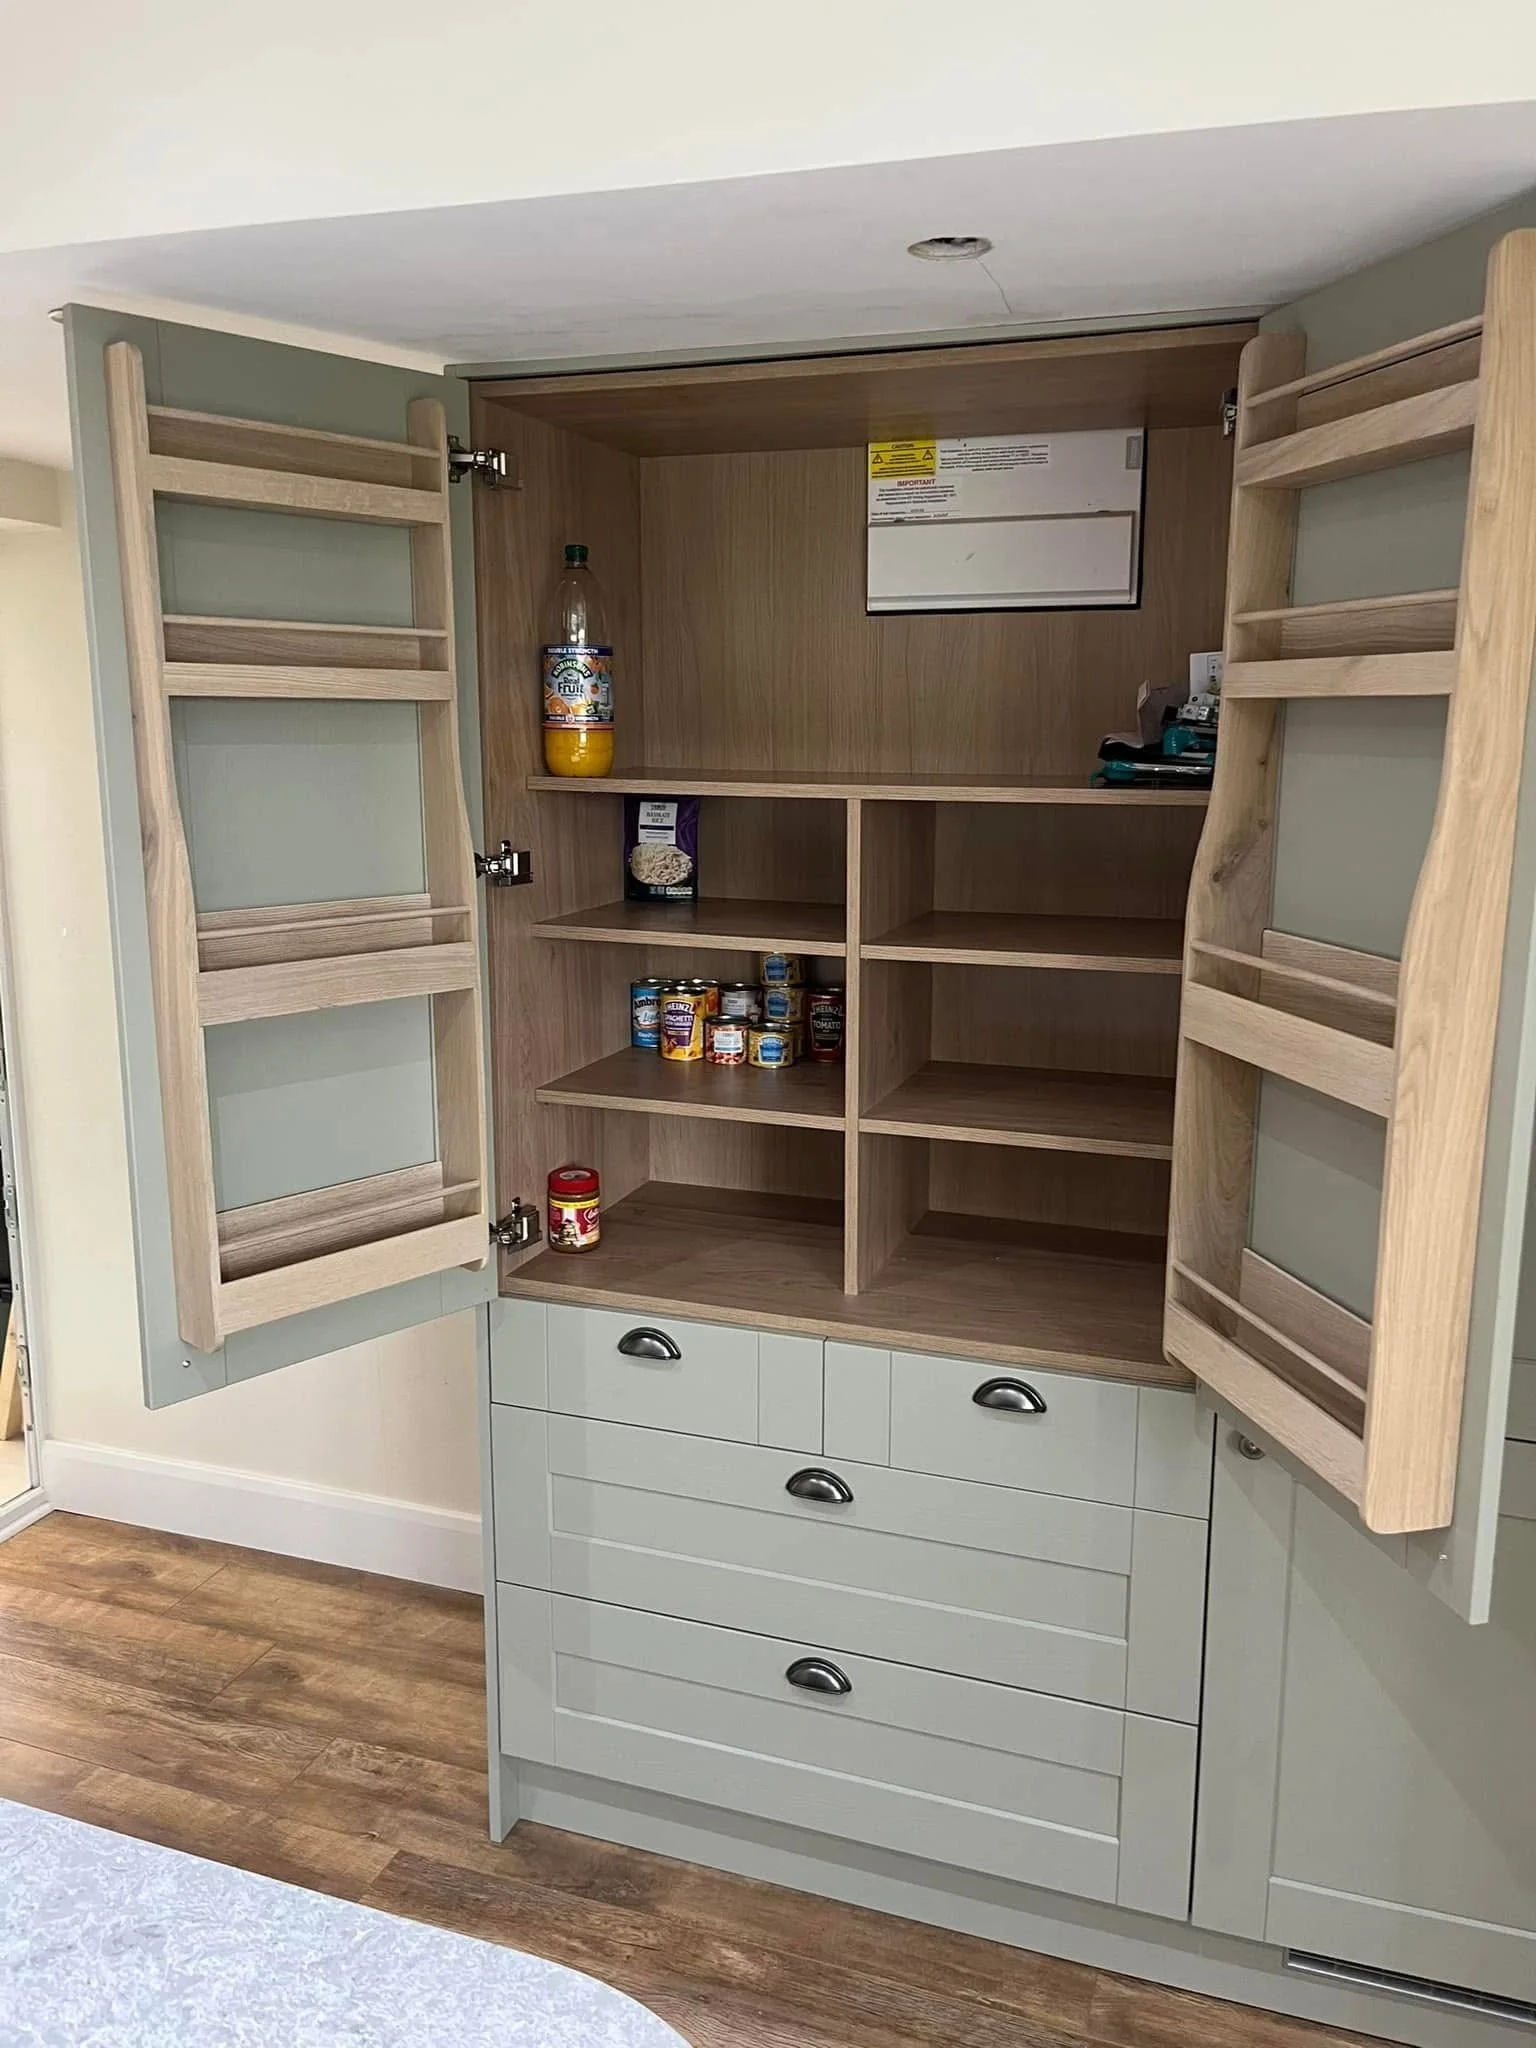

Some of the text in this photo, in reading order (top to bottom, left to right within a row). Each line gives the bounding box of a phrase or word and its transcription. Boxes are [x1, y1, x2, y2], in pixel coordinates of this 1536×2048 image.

[896, 478, 937, 487] IMPORTANT
[567, 647, 599, 655] STRENGTH
[552, 659, 592, 677] ROBINSONS
[563, 676, 580, 684] Real
[558, 681, 585, 694] Fruit
[666, 1002, 690, 1011] HEINZ
[815, 1004, 839, 1014] HEINZ
[813, 1020, 841, 1029] TOMATO
